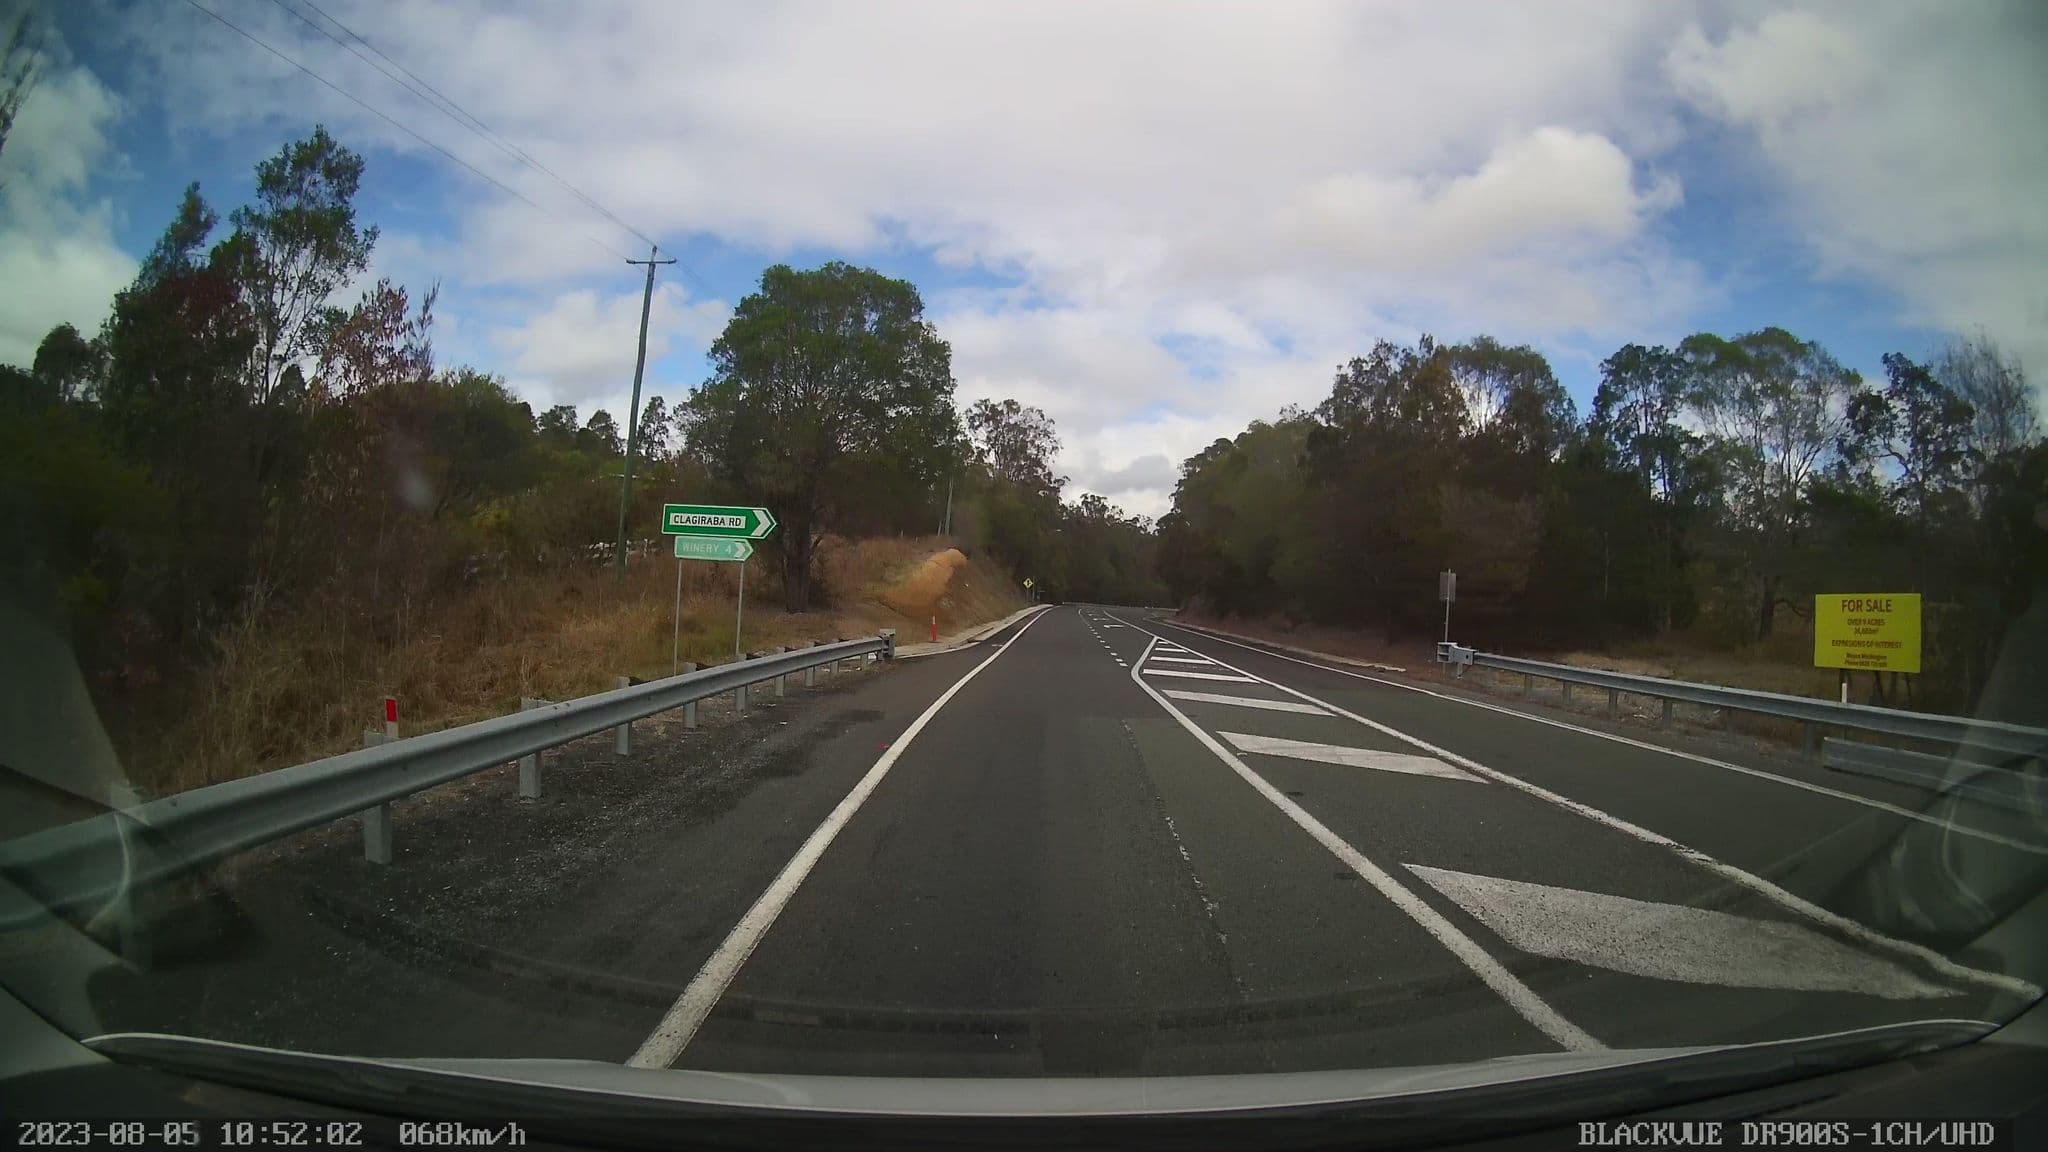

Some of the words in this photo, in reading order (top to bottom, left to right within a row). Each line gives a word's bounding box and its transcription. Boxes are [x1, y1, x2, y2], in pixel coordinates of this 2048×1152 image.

[673, 515, 726, 526] CLAGIRABA
[728, 517, 742, 527] RD
[682, 543, 719, 553] WINERY
[1841, 599, 1863, 613] FOR
[1865, 599, 1892, 613] SALE
